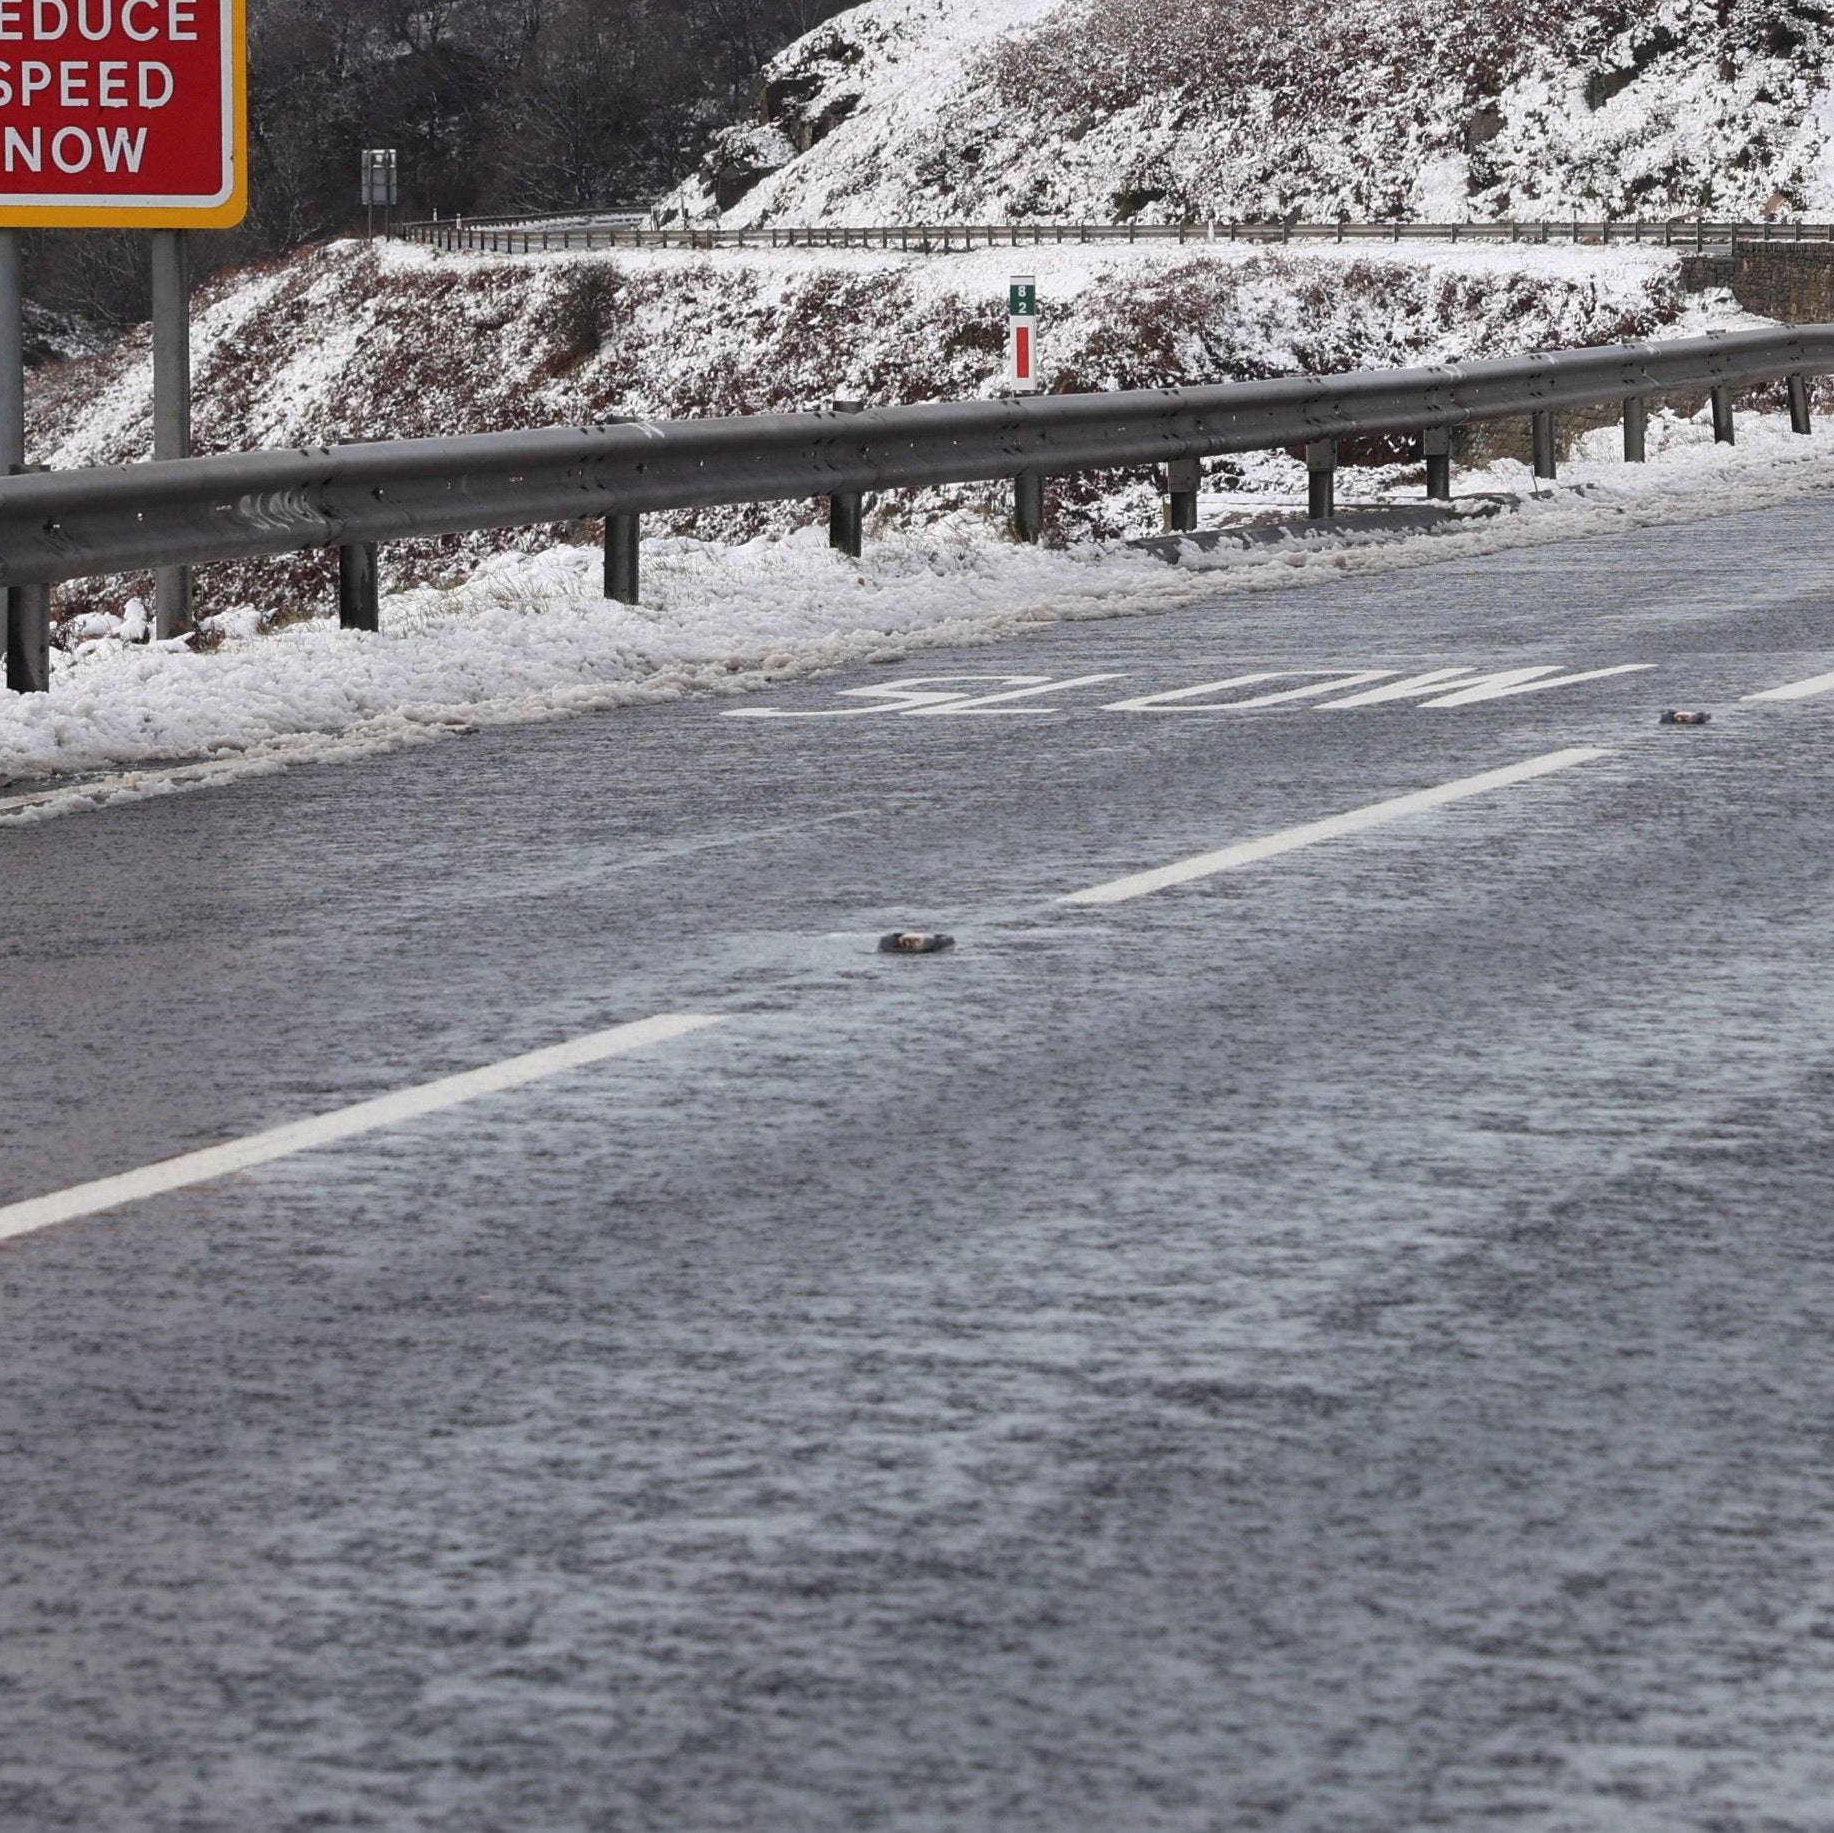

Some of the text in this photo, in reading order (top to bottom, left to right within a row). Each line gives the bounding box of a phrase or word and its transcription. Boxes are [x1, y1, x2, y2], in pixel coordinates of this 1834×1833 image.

[4, 126, 148, 174] NOW
[1017, 285, 1027, 297] 8
[1018, 301, 1027, 314] 2
[718, 663, 1660, 717] SLOW
